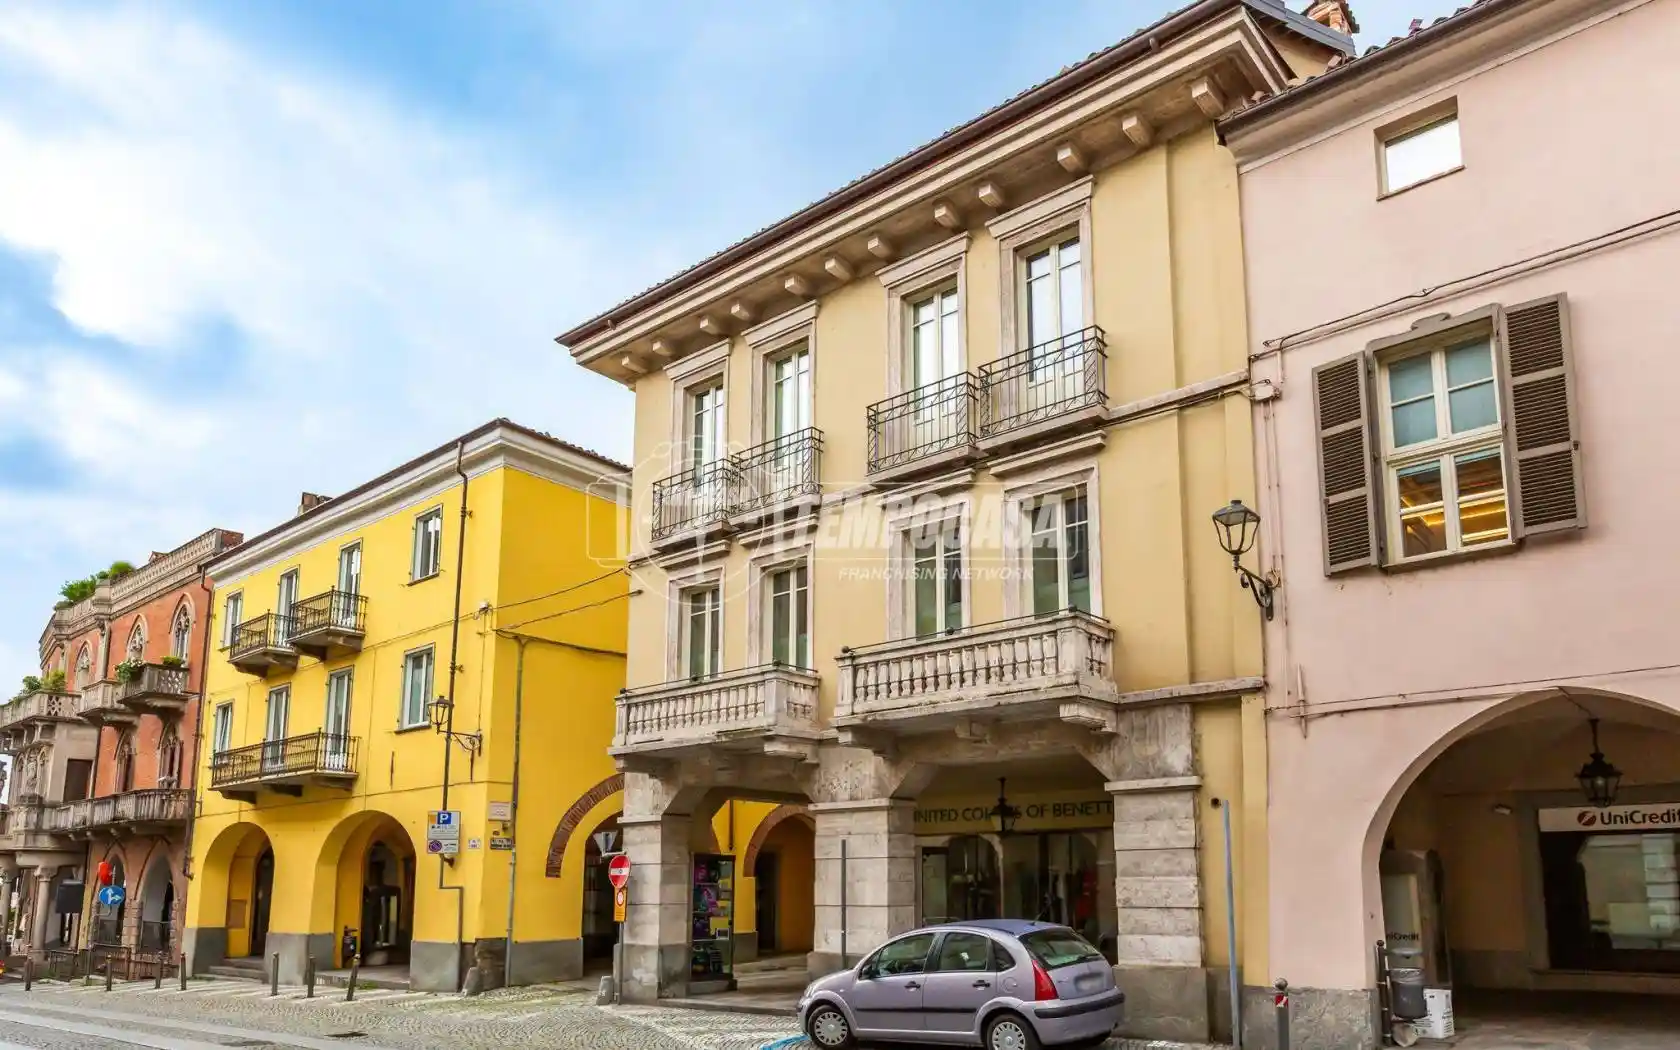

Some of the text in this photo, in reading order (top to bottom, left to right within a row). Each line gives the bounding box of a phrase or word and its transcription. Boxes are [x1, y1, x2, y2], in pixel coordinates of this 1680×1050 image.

[1026, 803, 1050, 818] OF
[1053, 799, 1113, 817] BENETT
[439, 813, 449, 824] P
